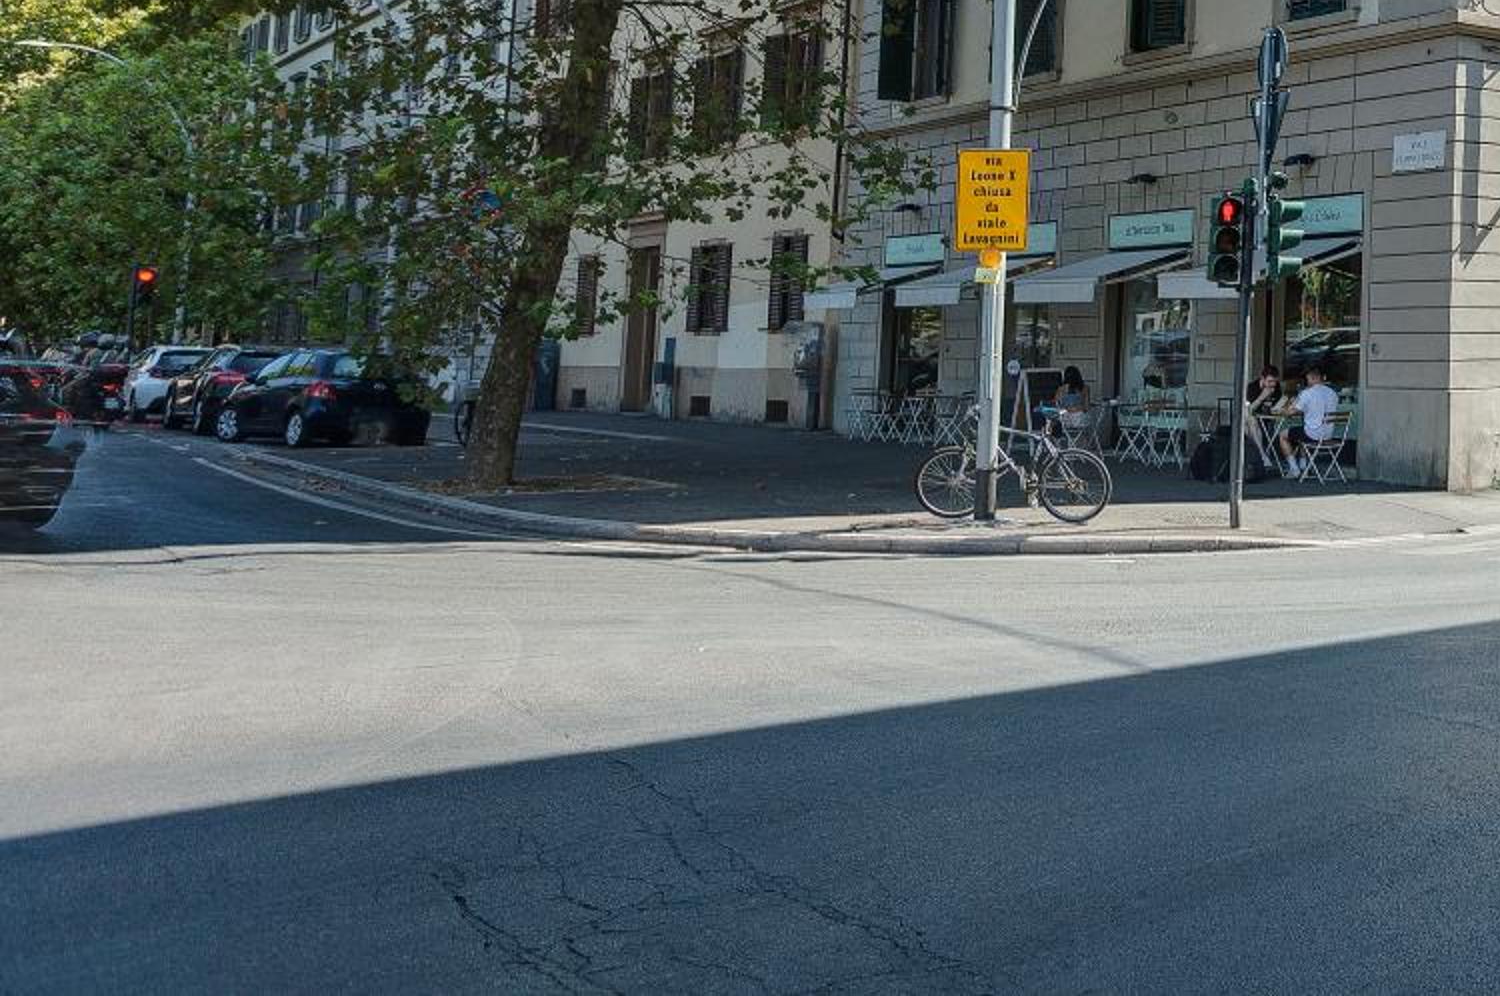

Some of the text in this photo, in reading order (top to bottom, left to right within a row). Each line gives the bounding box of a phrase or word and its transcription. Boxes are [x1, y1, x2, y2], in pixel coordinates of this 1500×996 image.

[985, 157, 1002, 166] via
[971, 170, 1005, 181] Leone
[973, 186, 1012, 197] chiusa
[985, 202, 999, 213] da
[977, 218, 1008, 229] viale
[963, 232, 1020, 246] Lavagnini
